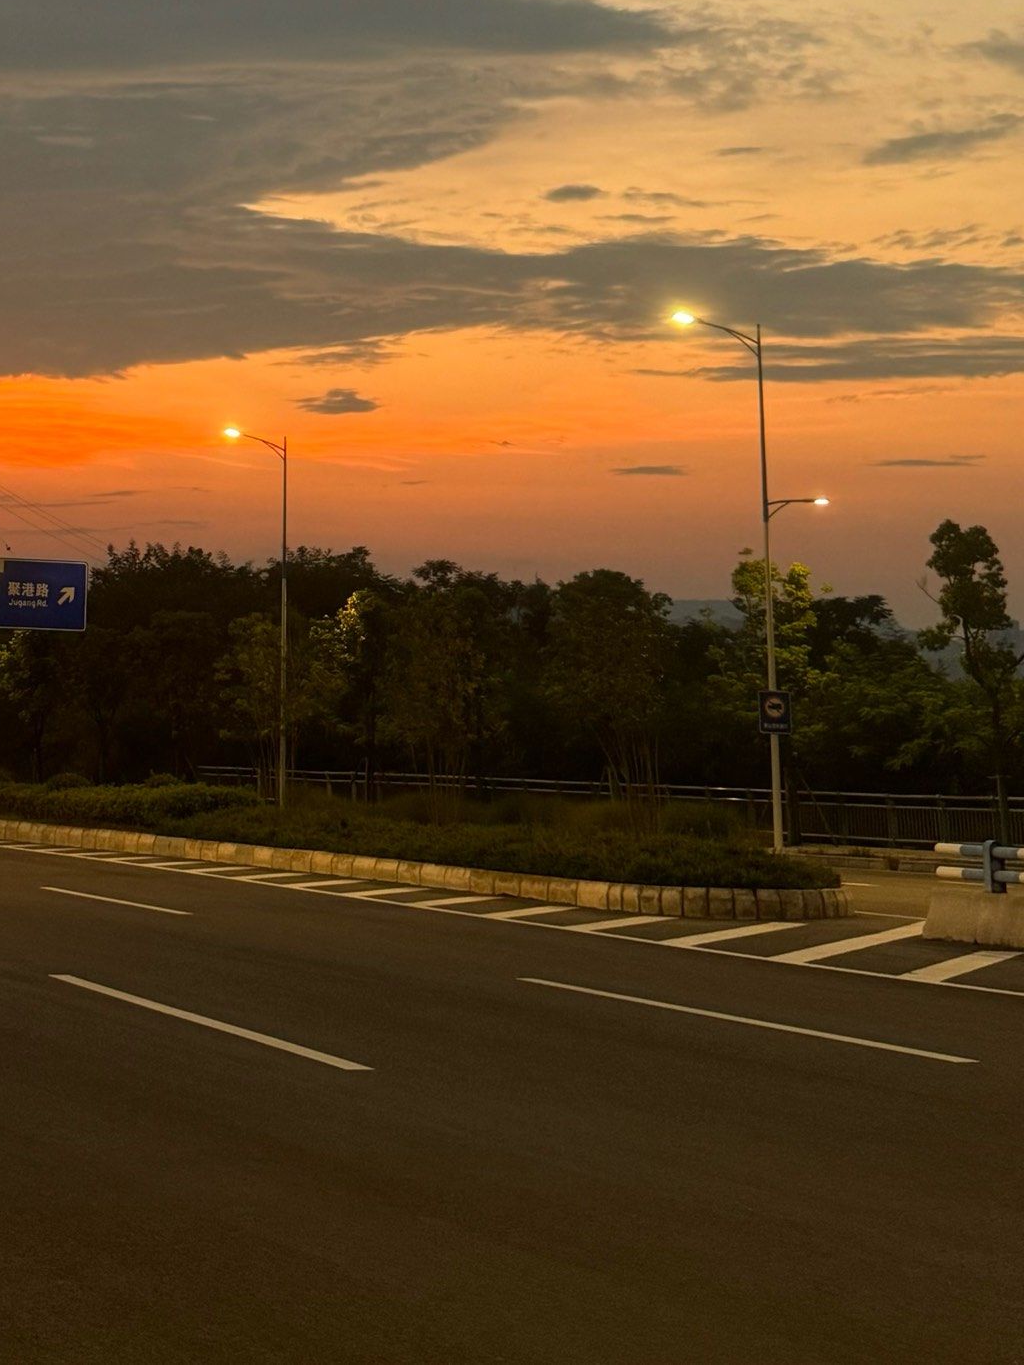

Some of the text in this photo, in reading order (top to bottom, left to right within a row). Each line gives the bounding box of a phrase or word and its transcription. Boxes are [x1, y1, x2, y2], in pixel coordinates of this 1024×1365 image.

[7, 581, 49, 597] 聚港路
[8, 598, 36, 609] Jugang
